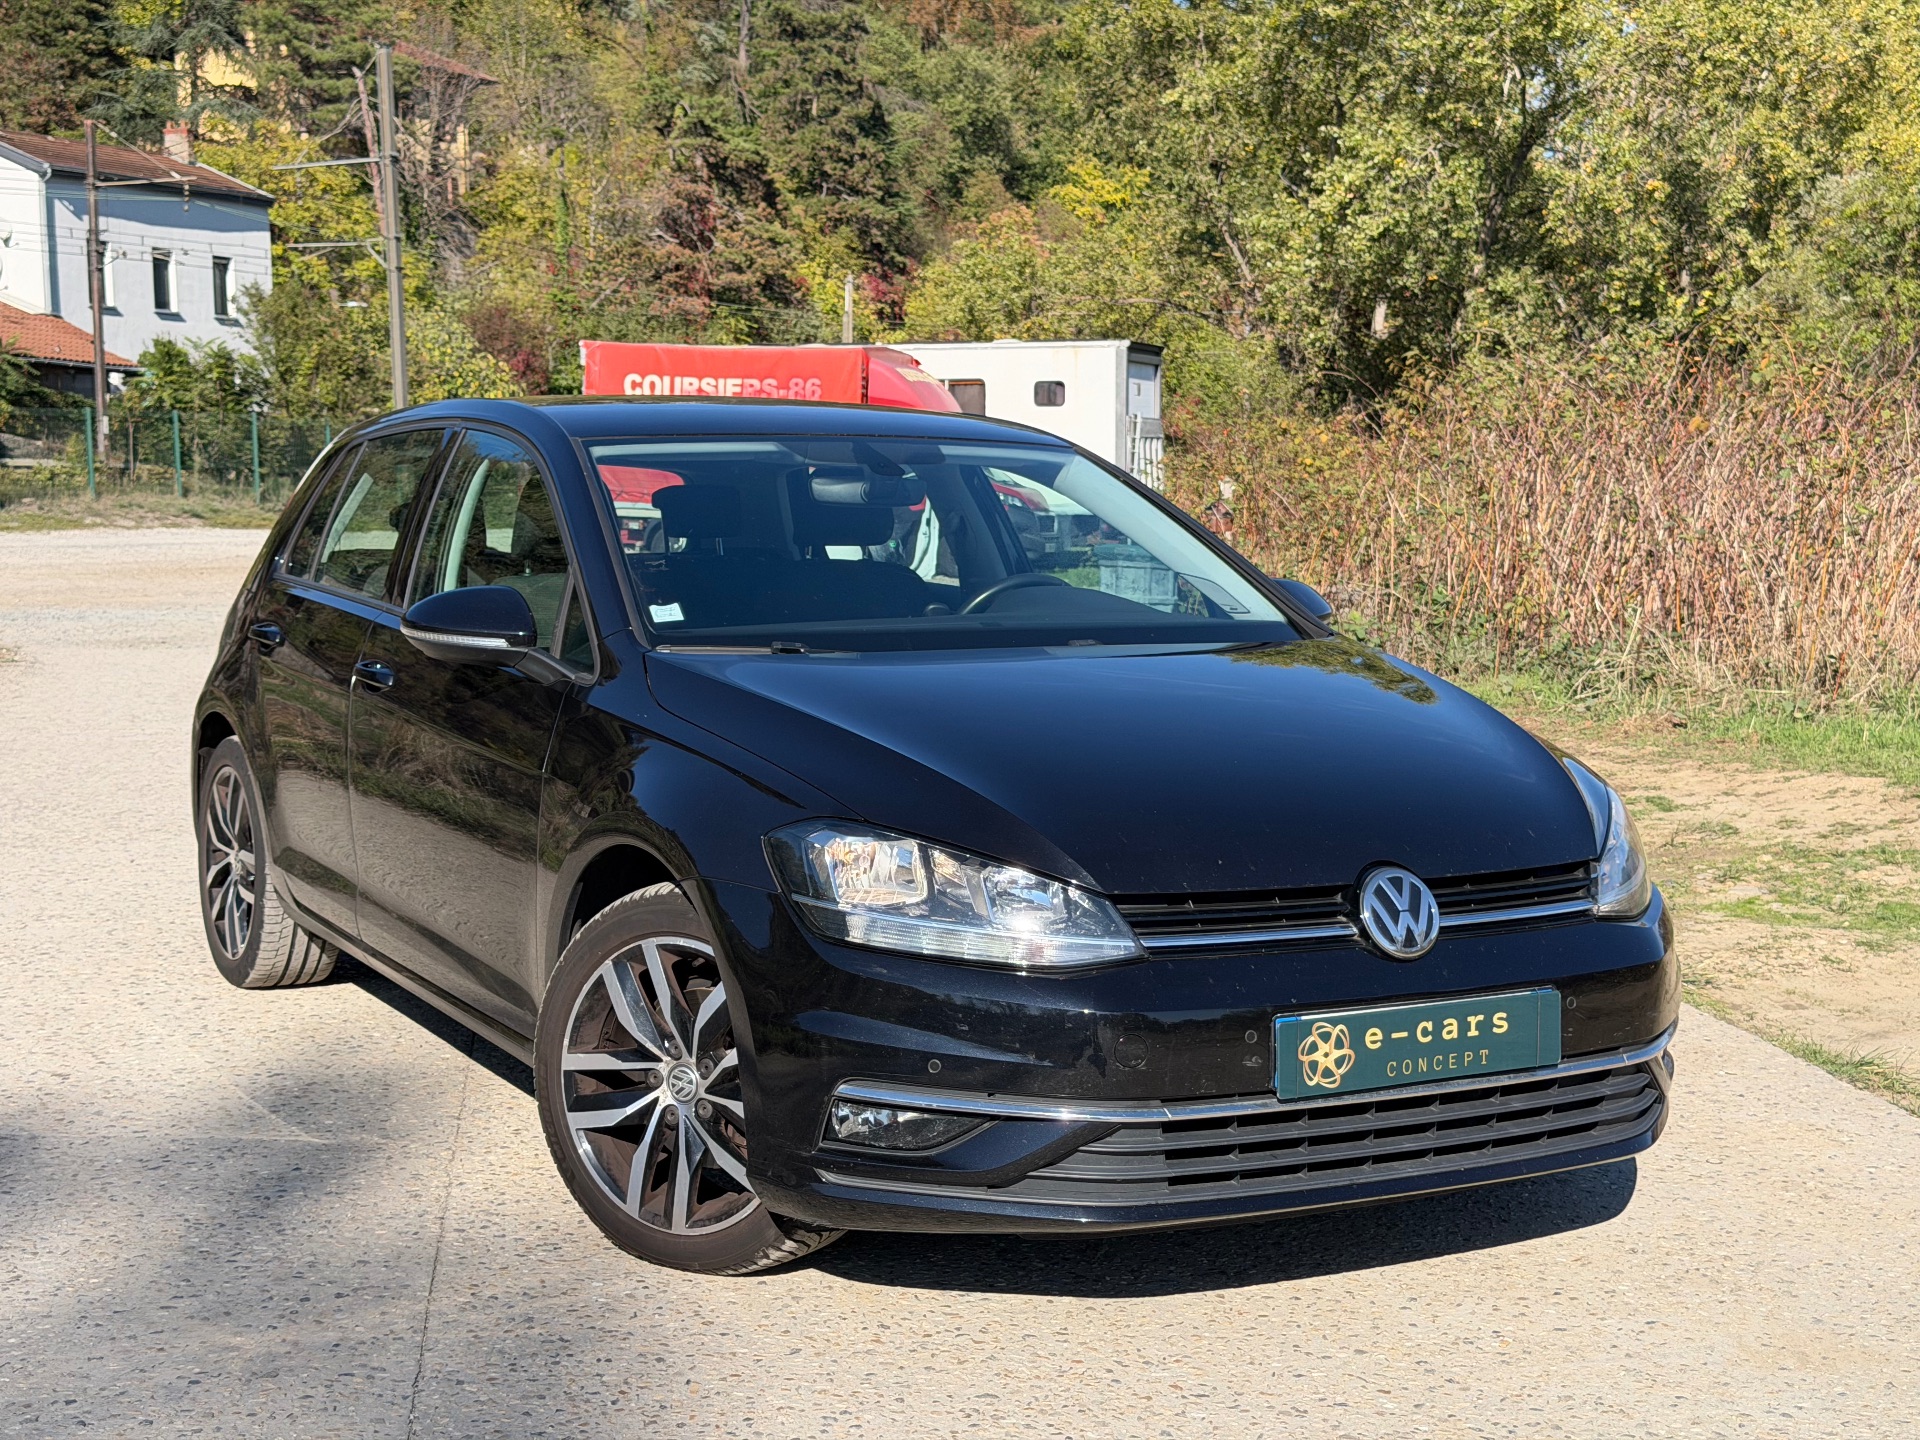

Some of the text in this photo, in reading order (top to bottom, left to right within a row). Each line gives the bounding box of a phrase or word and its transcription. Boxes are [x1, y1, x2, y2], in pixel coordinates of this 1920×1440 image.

[1362, 868, 1439, 956] VW
[1365, 1011, 1509, 1049] e-cars
[1387, 1050, 1489, 1077] CONCEPT
